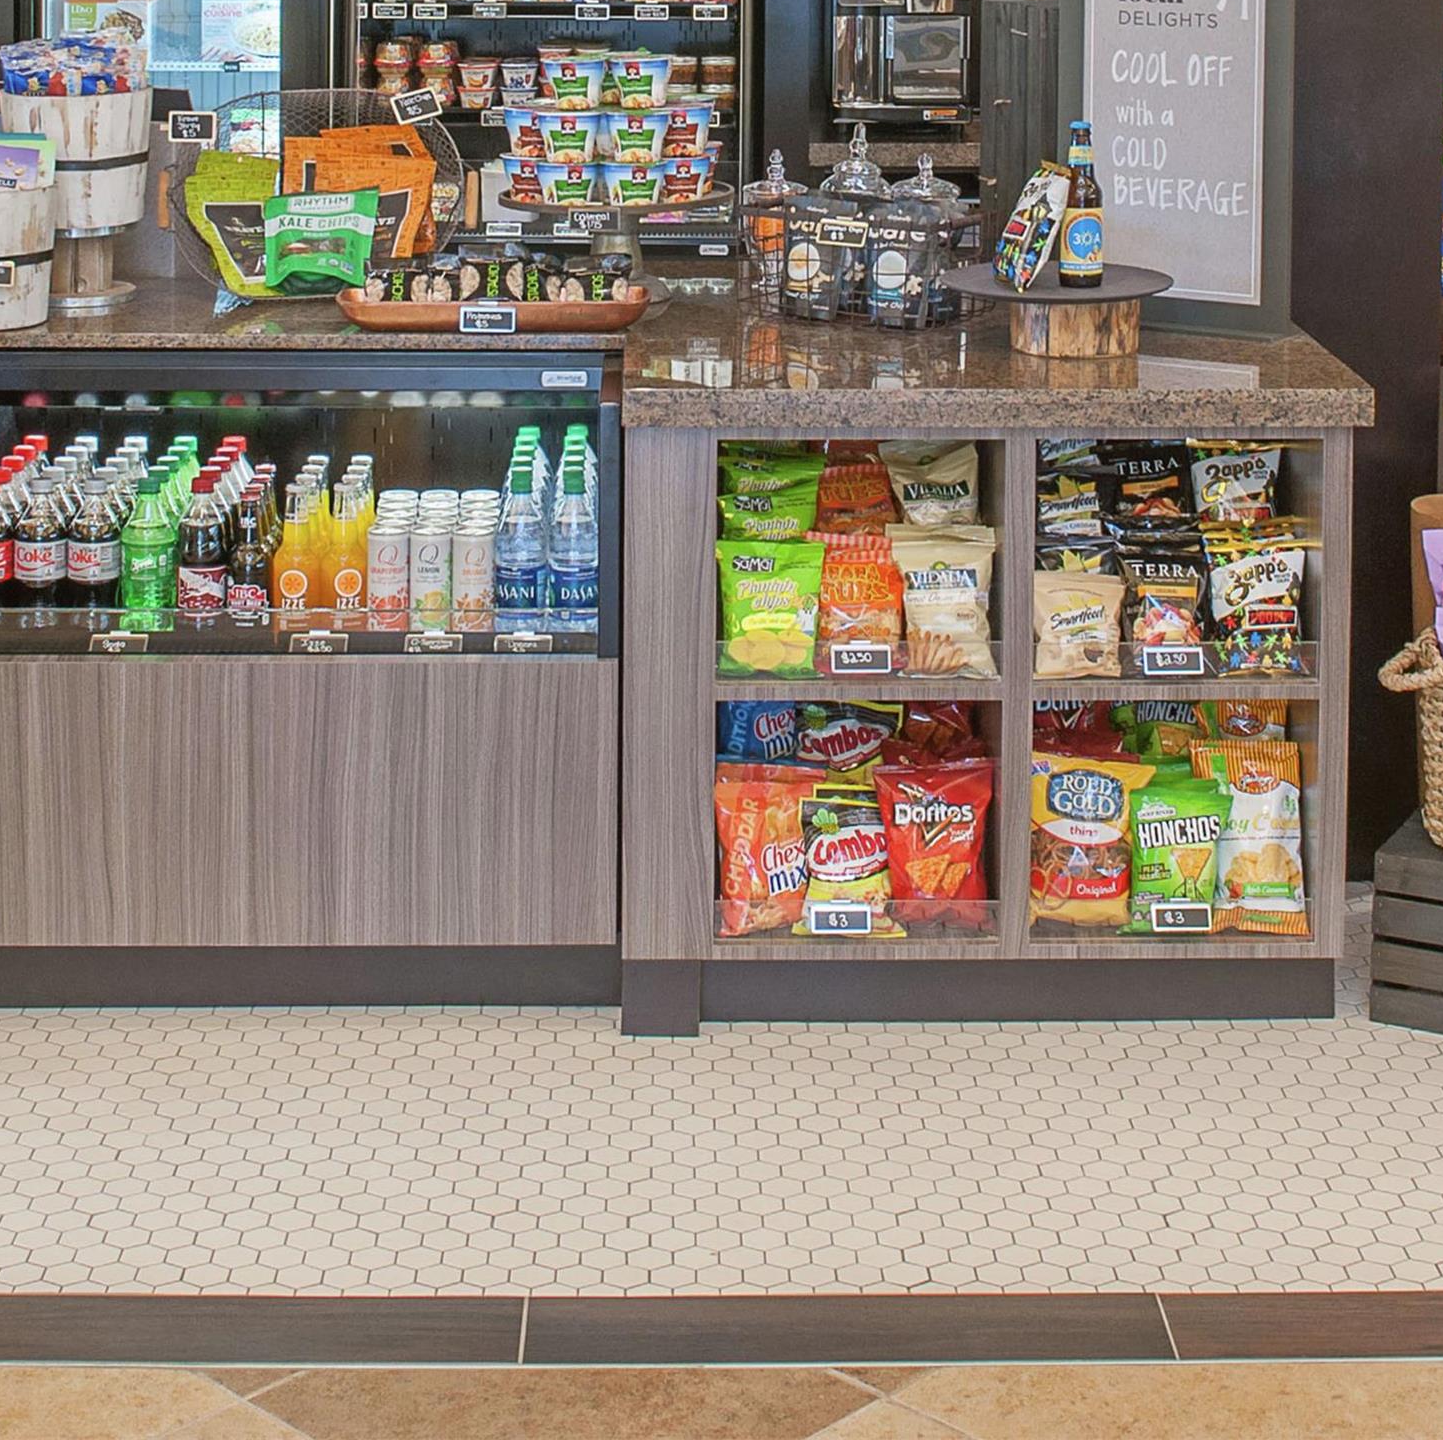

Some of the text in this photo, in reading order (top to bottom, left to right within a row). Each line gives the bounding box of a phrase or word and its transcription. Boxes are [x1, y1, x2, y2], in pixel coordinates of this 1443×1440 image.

[1118, 10, 1219, 29] DELIGHTS
[1111, 49, 1234, 88] COOL OFF
[1115, 99, 1175, 127] with a
[1111, 135, 1168, 171] COLD
[1113, 173, 1249, 216] BEVERAGE
[278, 215, 359, 229] KALE CHIPS
[1117, 456, 1180, 476] TERRA
[418, 543, 441, 566] Q
[417, 565, 441, 575] LEMON
[1131, 563, 1199, 578] TERRA
[281, 597, 306, 610] IZZE
[336, 596, 361, 610] IZZE
[1137, 701, 1197, 724] HONCHO
[754, 710, 795, 740] Chex
[800, 724, 883, 756] Combos
[1061, 775, 1115, 793] ROLD
[1053, 789, 1118, 815] GOLD
[894, 804, 974, 825] Doritos
[1138, 816, 1221, 849] HONCHOS
[725, 798, 759, 895] CHEDDAR
[761, 841, 807, 873] Chex
[813, 827, 889, 866] Combo
[769, 864, 807, 895] mix
[1076, 884, 1118, 898] Original
[827, 912, 849, 929] $3
[1163, 911, 1186, 923] $3
